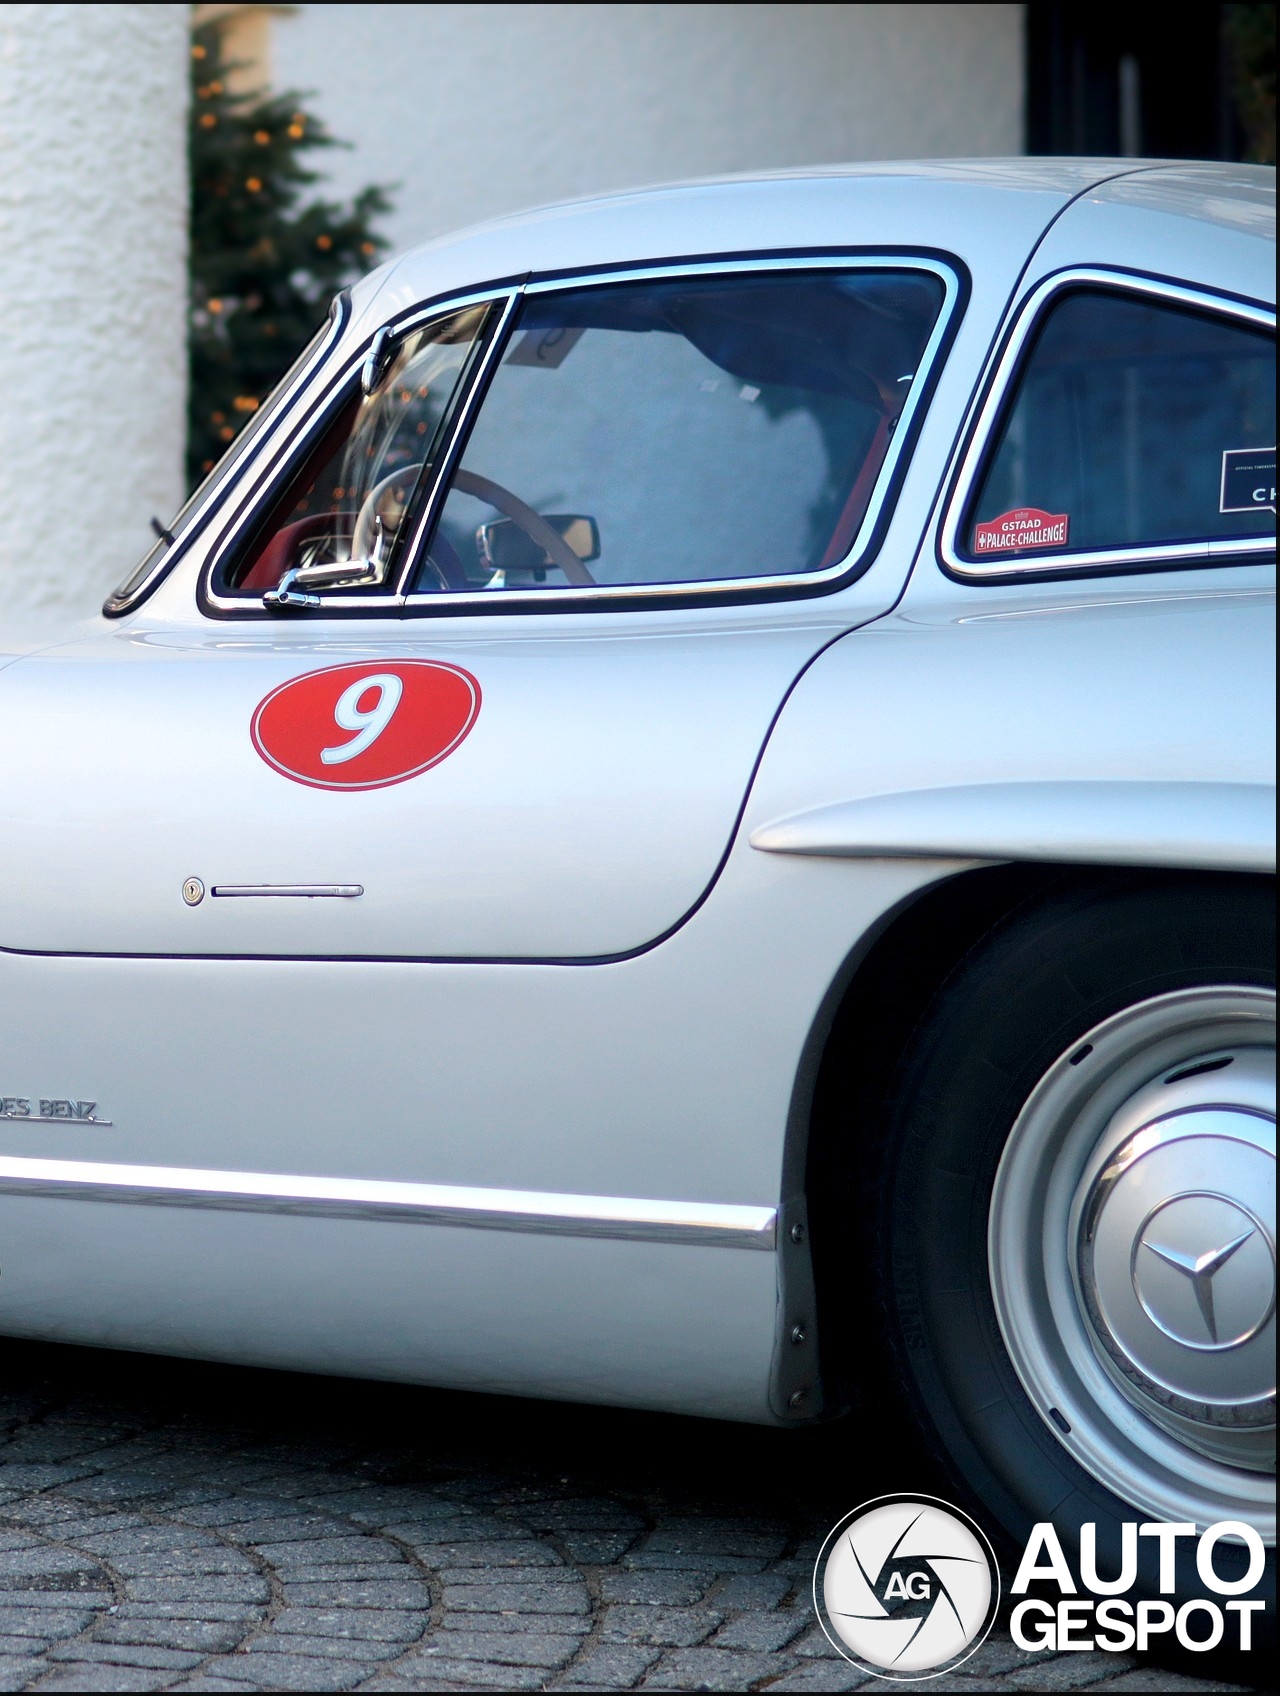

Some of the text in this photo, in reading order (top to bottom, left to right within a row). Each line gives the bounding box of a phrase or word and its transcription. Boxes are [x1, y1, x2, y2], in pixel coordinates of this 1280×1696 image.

[986, 522, 1065, 548] PALACE-CHALLENGE
[1001, 519, 1041, 531] GSTAAD
[320, 673, 403, 765] 9
[39, 1098, 97, 1119] BENZ
